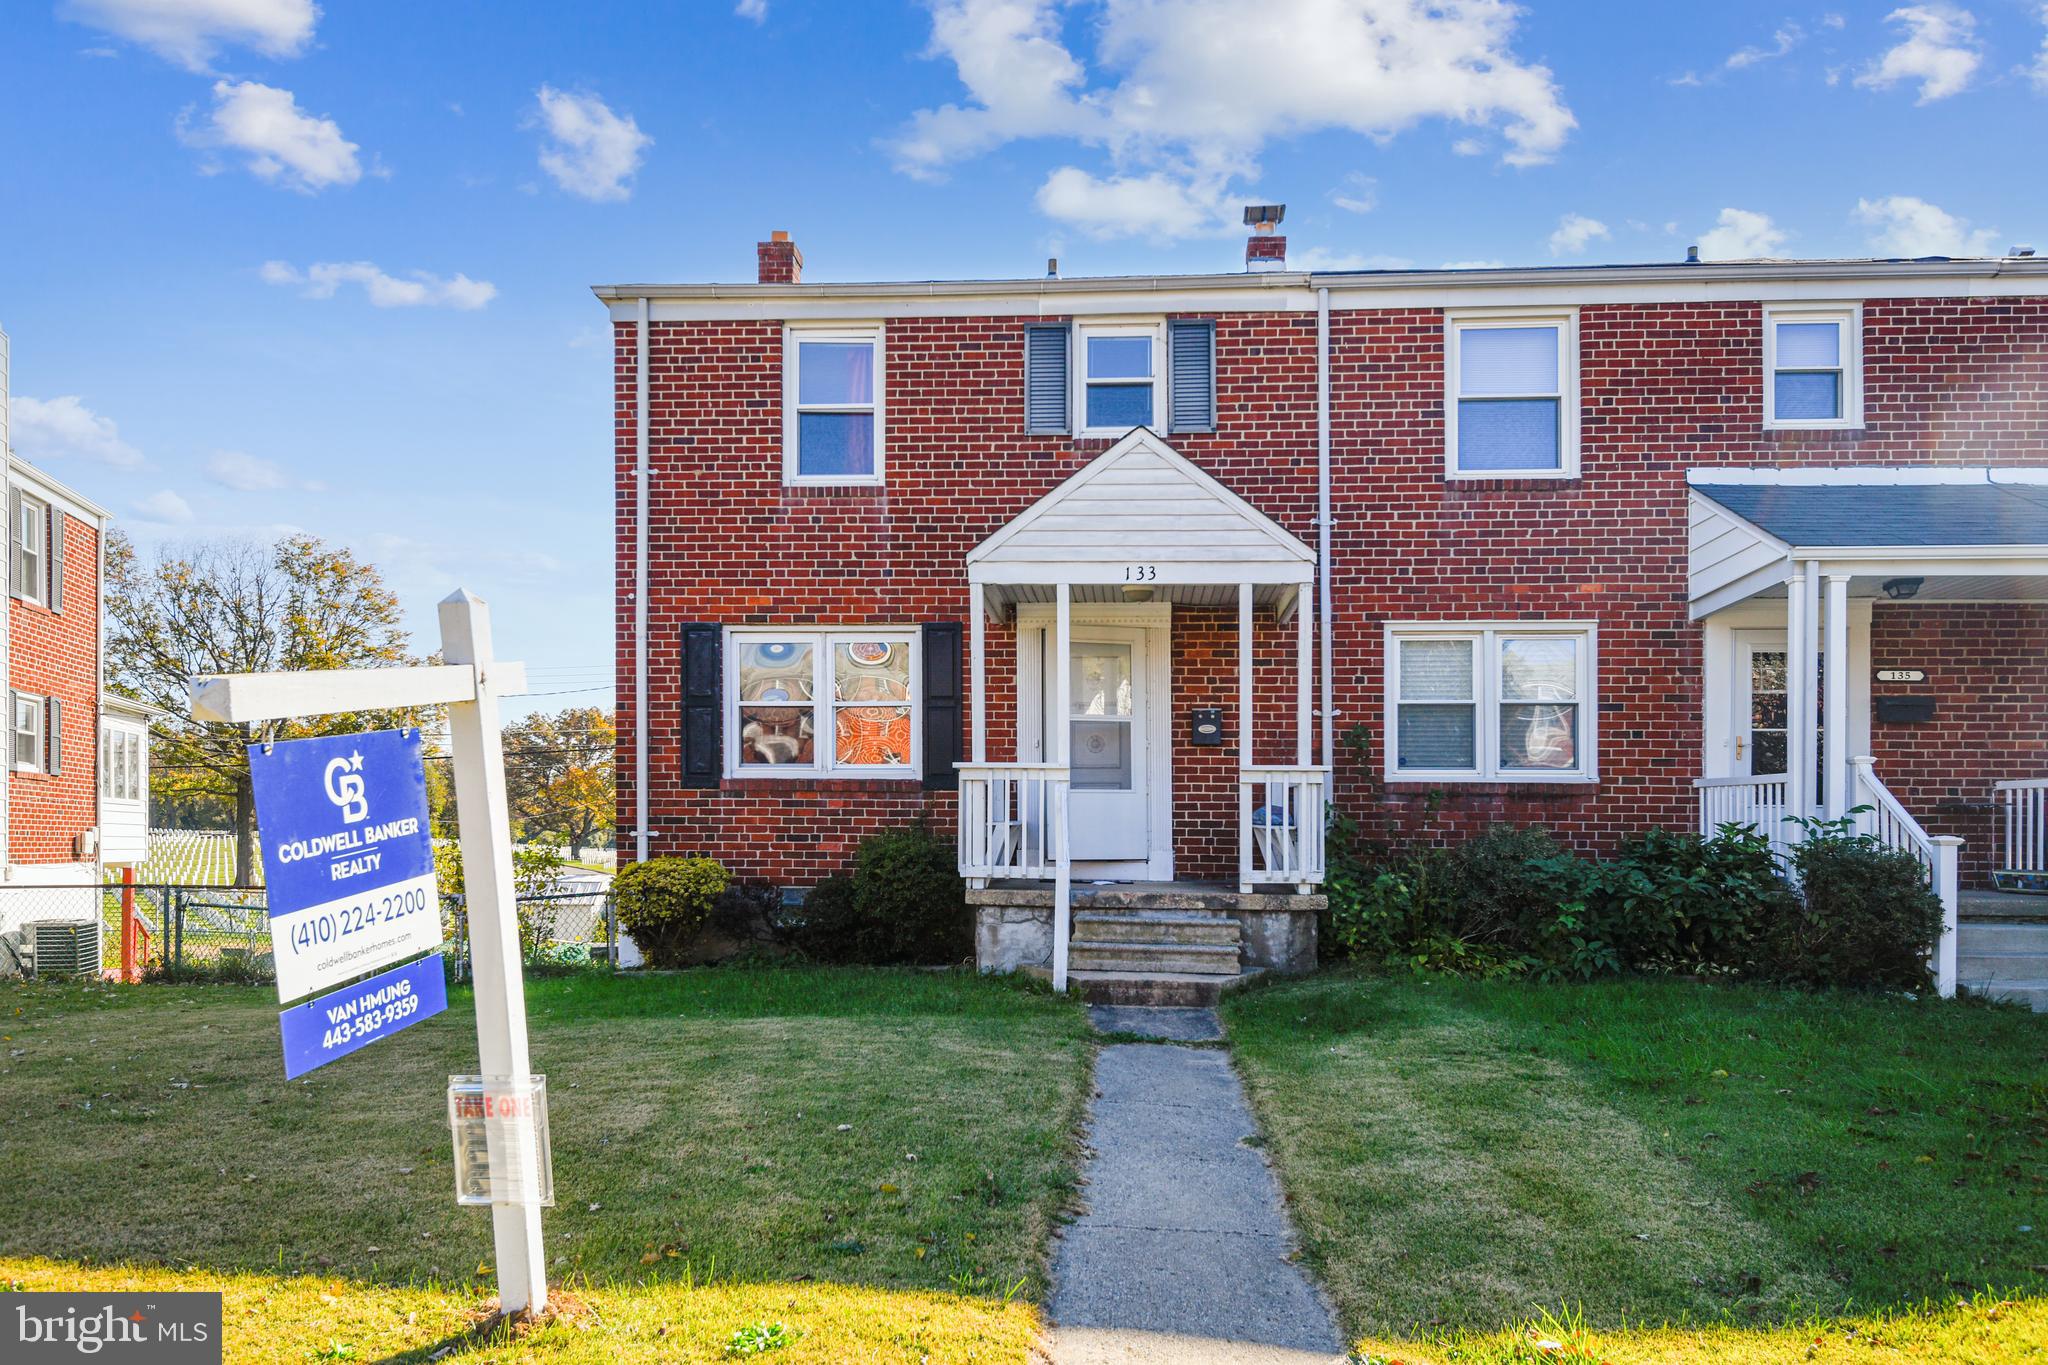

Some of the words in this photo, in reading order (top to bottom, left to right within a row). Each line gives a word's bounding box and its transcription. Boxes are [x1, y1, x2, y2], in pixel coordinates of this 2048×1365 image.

[1126, 566, 1156, 580] 133
[1891, 671, 1911, 680] 135
[278, 831, 363, 864] COLDWELL
[364, 817, 419, 845] BANKER
[330, 853, 382, 881] REALTY
[291, 913, 337, 955] (410)
[340, 887, 426, 936] 224-2200
[316, 931, 412, 972] coldwellbankerhomes.com
[322, 994, 419, 1049] 443-583-9359
[326, 999, 358, 1025] VAN
[359, 979, 411, 1013] HMUNG
[454, 1095, 494, 1119] TAKE
[499, 1095, 532, 1118] ONE
